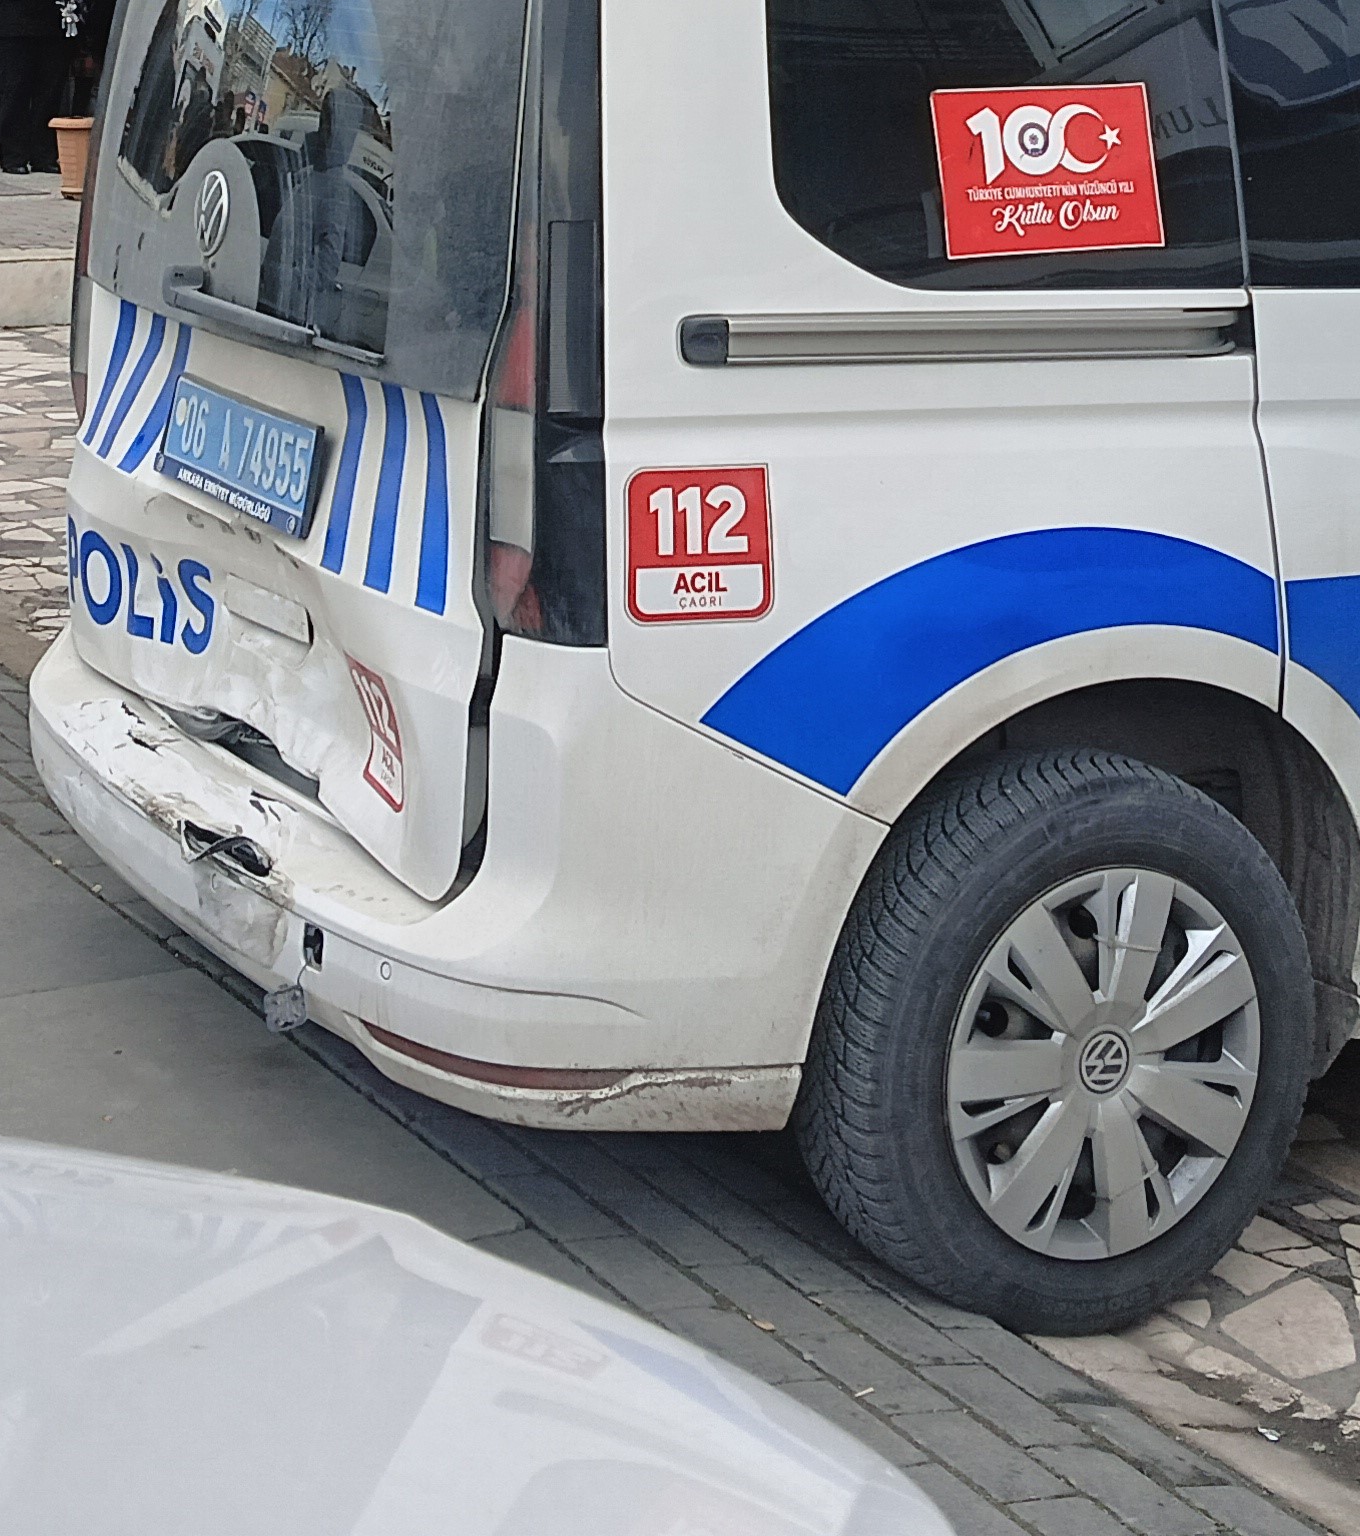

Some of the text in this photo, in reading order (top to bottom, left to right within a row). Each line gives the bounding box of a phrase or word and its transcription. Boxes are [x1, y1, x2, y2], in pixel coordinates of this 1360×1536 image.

[992, 199, 1121, 237] Kutlu Olsun
[237, 416, 310, 504] 74955
[648, 484, 749, 556] 112
